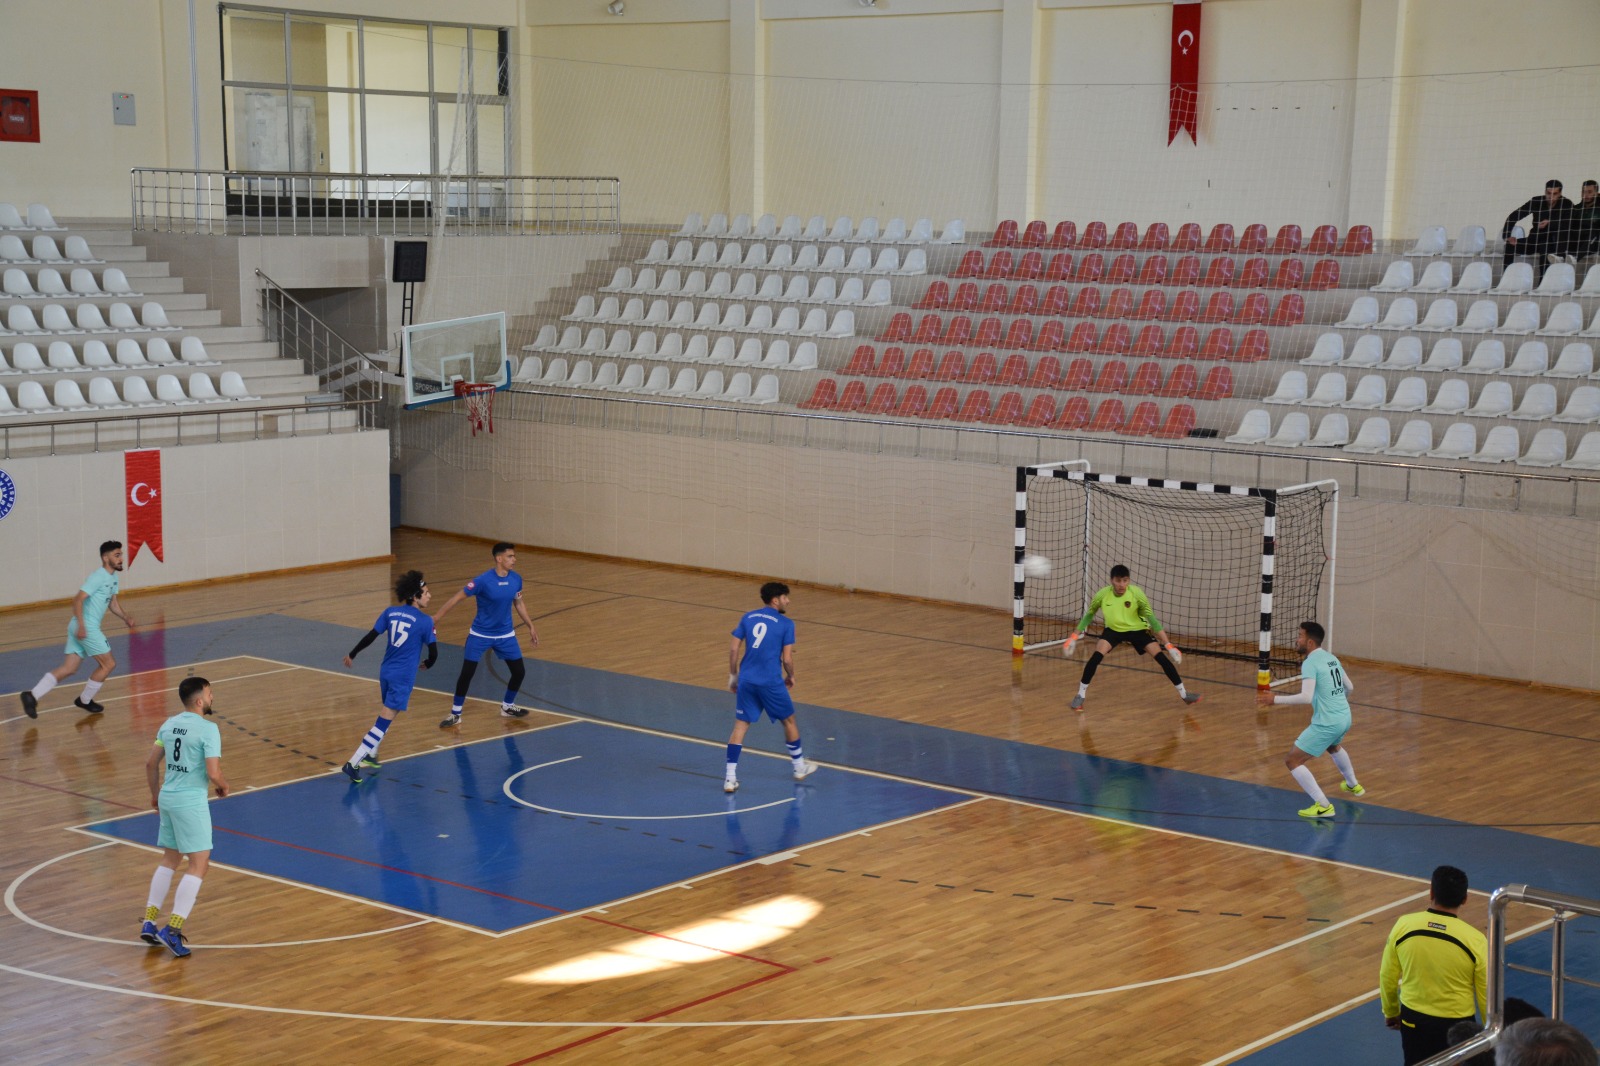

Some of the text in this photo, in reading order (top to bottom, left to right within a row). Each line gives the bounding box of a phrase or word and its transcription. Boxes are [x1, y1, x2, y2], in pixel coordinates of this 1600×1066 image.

[390, 619, 412, 648] 15
[752, 622, 768, 649] 9
[1330, 667, 1342, 688] 10
[172, 727, 188, 736] EMU
[173, 737, 182, 762] 8
